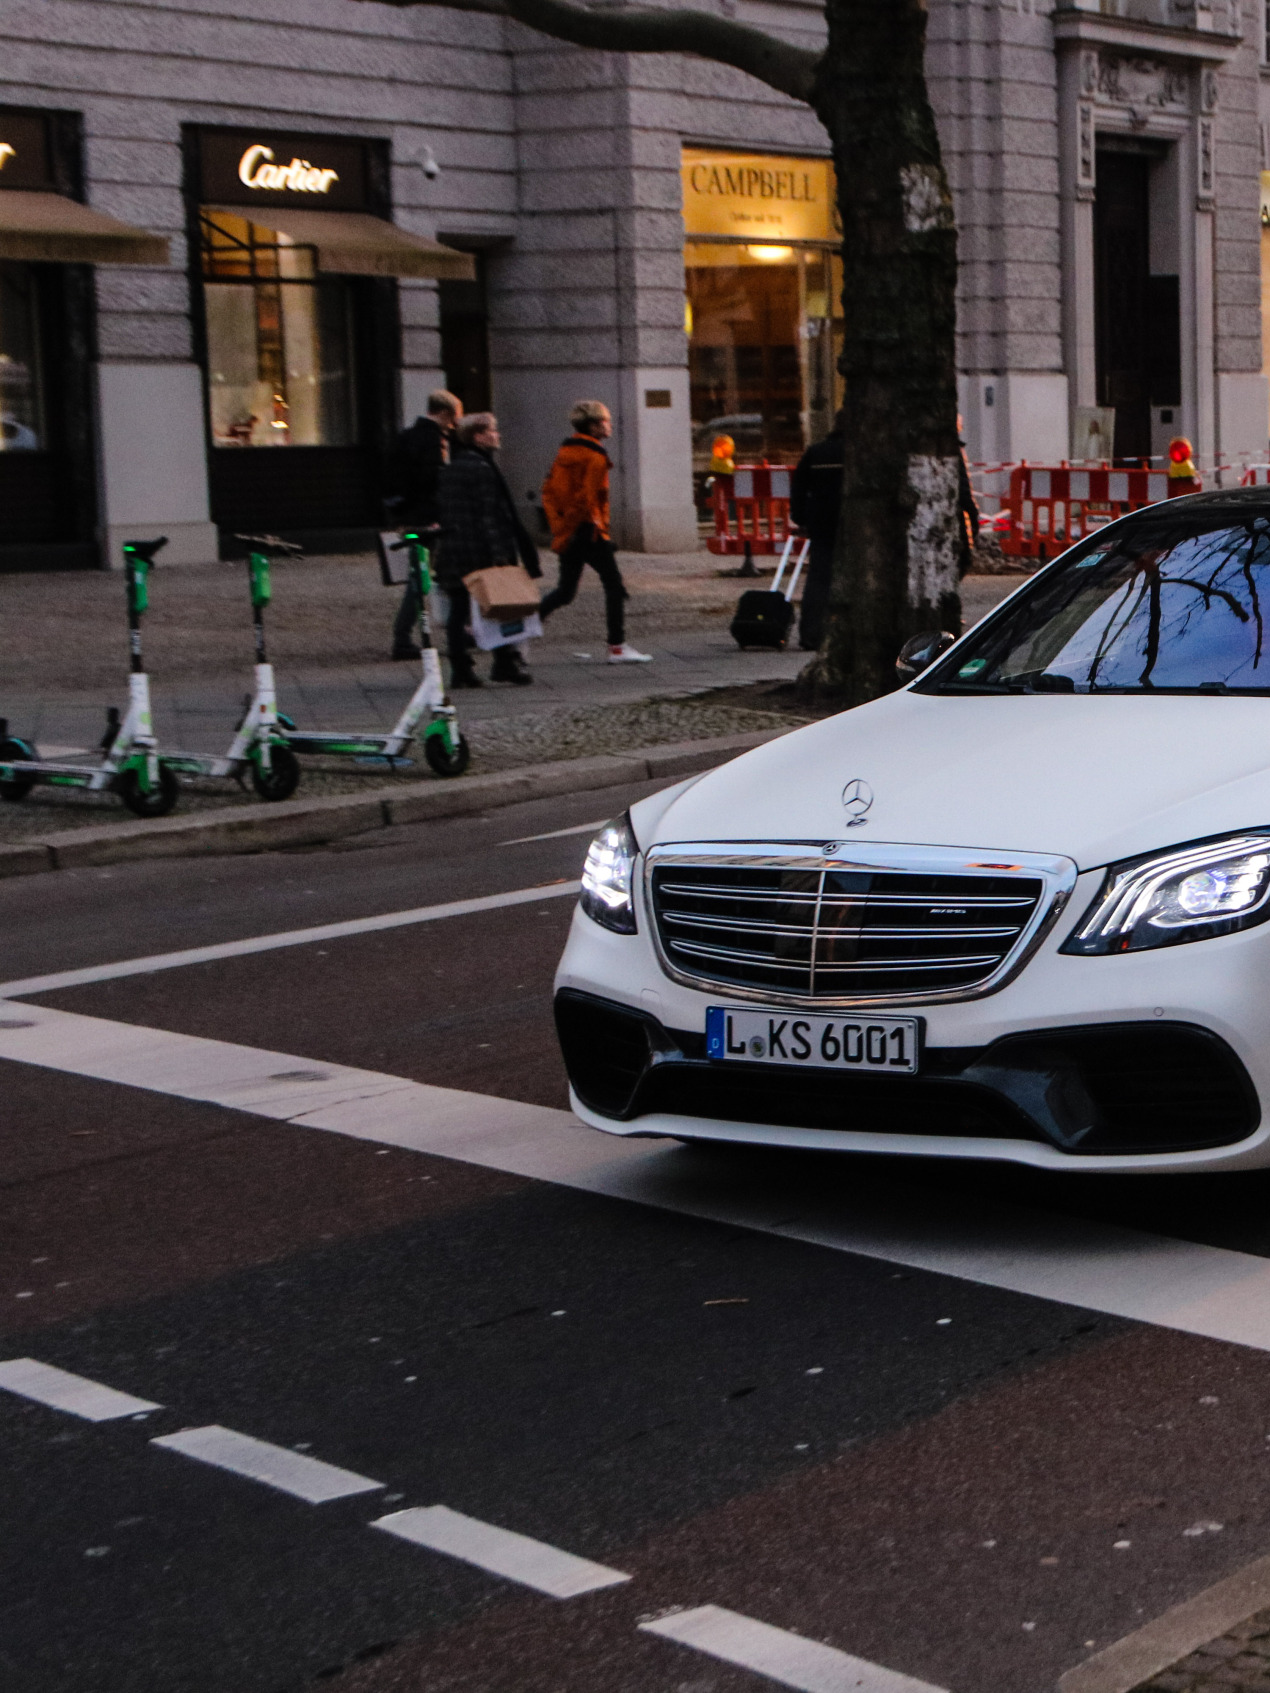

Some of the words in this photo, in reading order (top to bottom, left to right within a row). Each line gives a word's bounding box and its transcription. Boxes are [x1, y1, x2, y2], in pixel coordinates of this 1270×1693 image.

[238, 144, 338, 193] Cartier
[691, 164, 816, 202] CAMPBELL
[726, 1015, 746, 1054] L
[768, 1018, 812, 1060] KS
[820, 1022, 911, 1066] 6001
